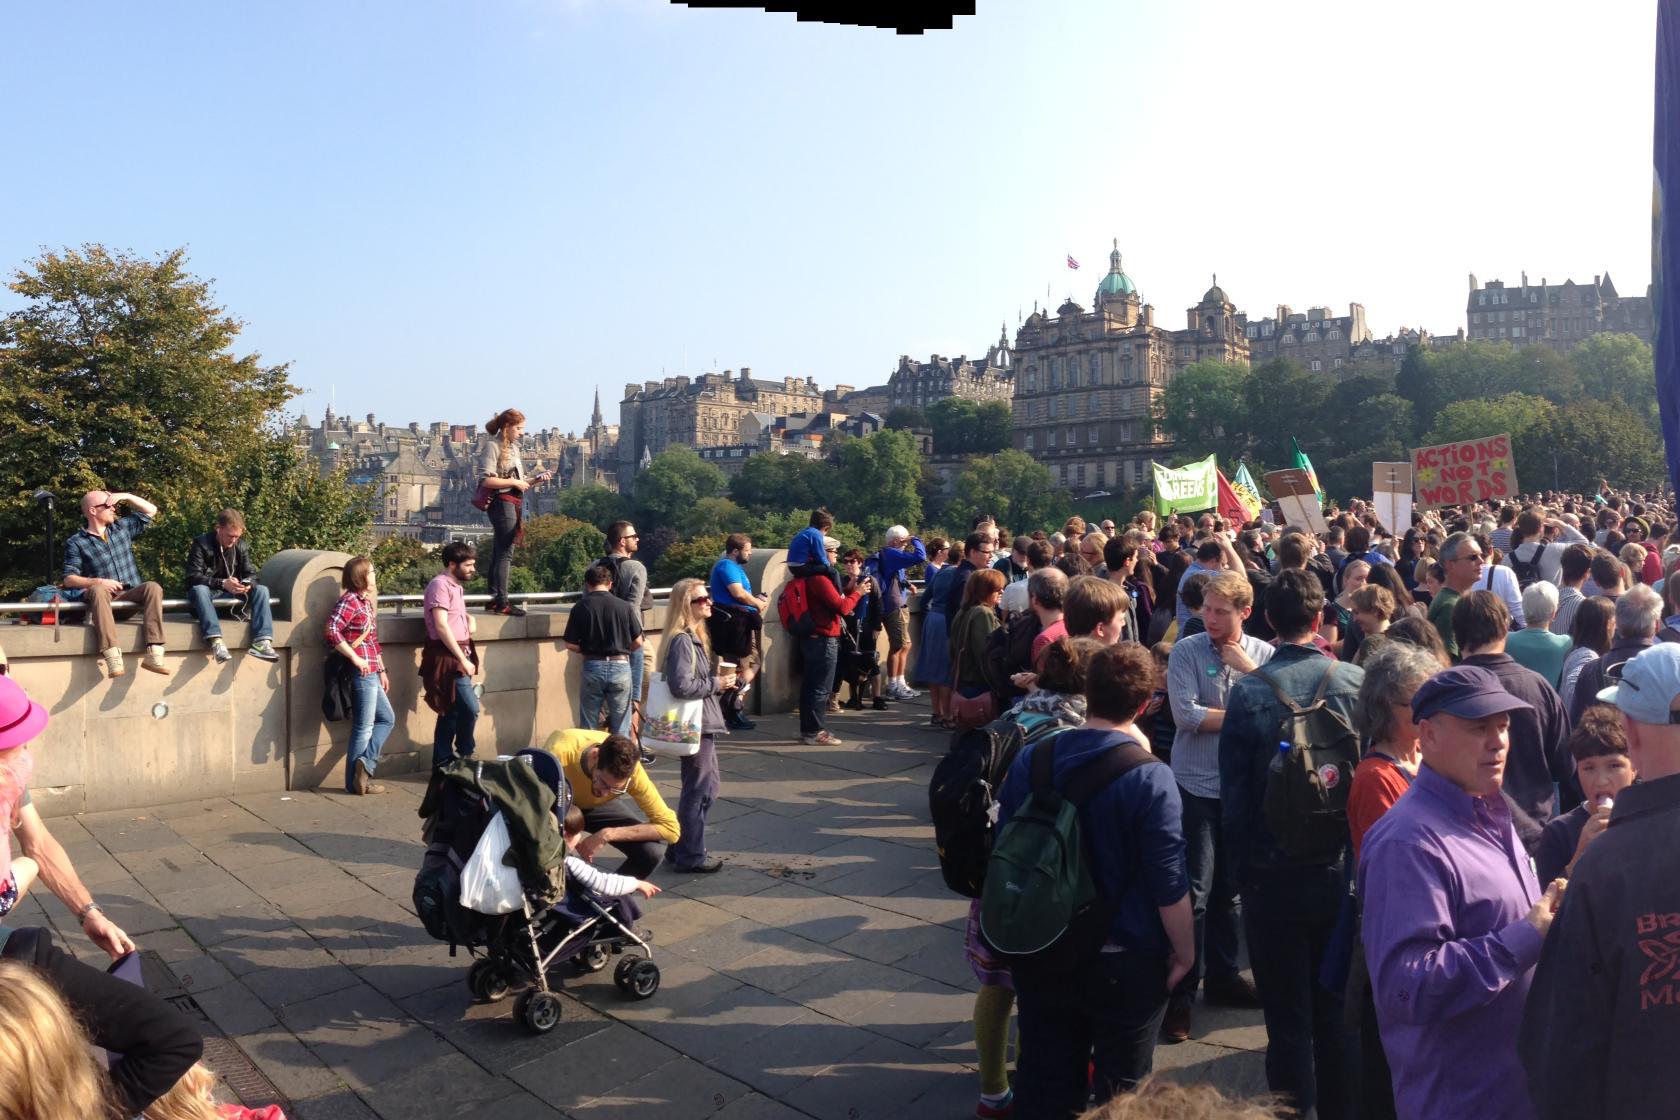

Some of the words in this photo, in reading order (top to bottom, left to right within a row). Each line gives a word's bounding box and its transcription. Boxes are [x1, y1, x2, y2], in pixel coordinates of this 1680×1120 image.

[1416, 437, 1508, 470] ACTIONS
[1420, 471, 1508, 506] WORDS
[1440, 461, 1491, 483] NOT
